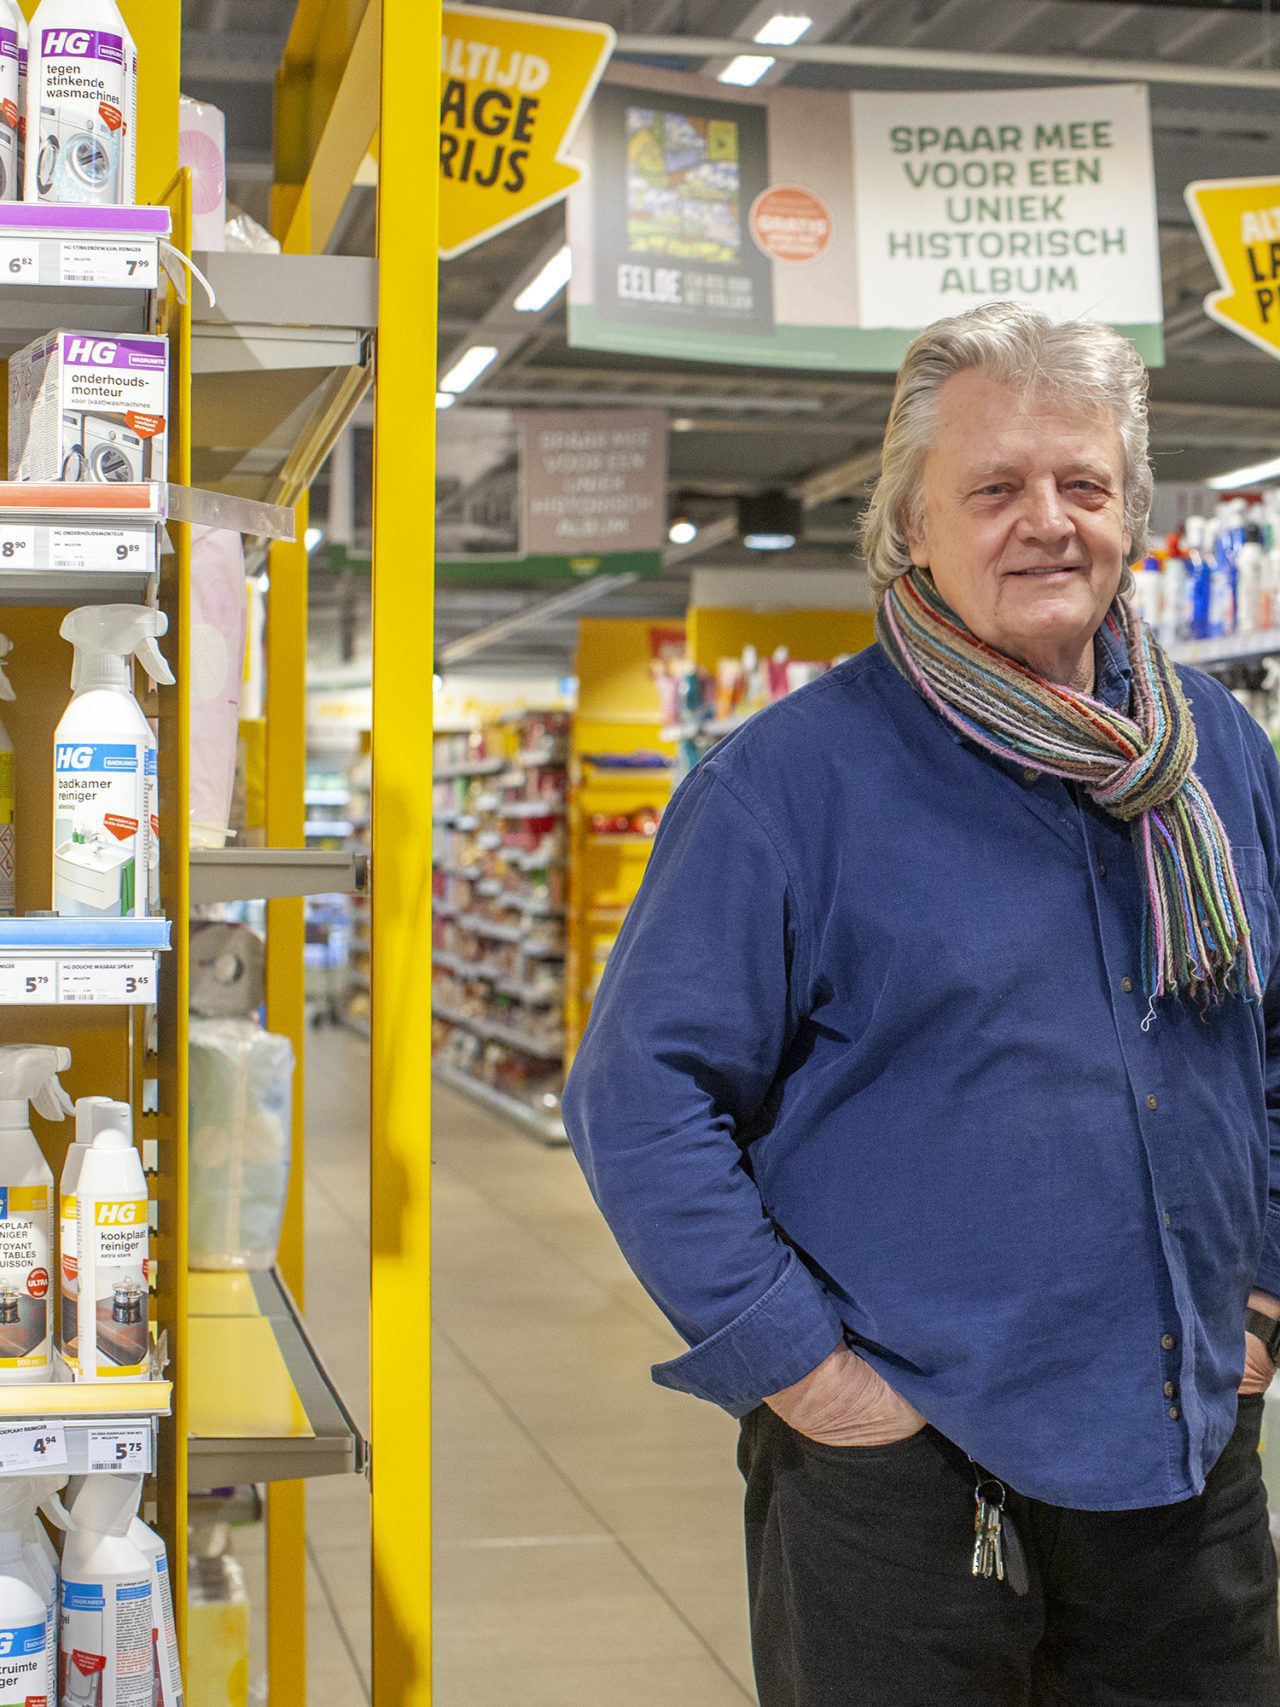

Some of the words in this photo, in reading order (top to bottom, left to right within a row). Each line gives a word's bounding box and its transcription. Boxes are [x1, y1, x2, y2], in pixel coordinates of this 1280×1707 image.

[44, 32, 90, 54] HG
[47, 64, 80, 75] tegen
[46, 76, 104, 88] stinkende
[46, 89, 120, 104] wasmachines
[441, 79, 539, 143] AGE
[890, 124, 1021, 153] SPAAR
[1035, 120, 1113, 150] MEE
[440, 133, 529, 192] RIJS
[904, 160, 1015, 188] VOOR
[1029, 157, 1100, 186] EEN
[947, 195, 1064, 223] UNIEK
[888, 227, 1126, 260] HISTORISCH
[940, 266, 1078, 294] ALBUM
[67, 340, 117, 364] HG
[72, 374, 149, 387] onderhouds-
[72, 386, 123, 397] monteur
[57, 747, 93, 769] HG
[58, 779, 112, 789] badkamer
[58, 791, 97, 803] reiniger
[98, 1204, 136, 1223] HG
[101, 1230, 145, 1241] kookplaat
[4, 1251, 36, 1260] TABLES
[101, 1241, 139, 1252] reiniger
